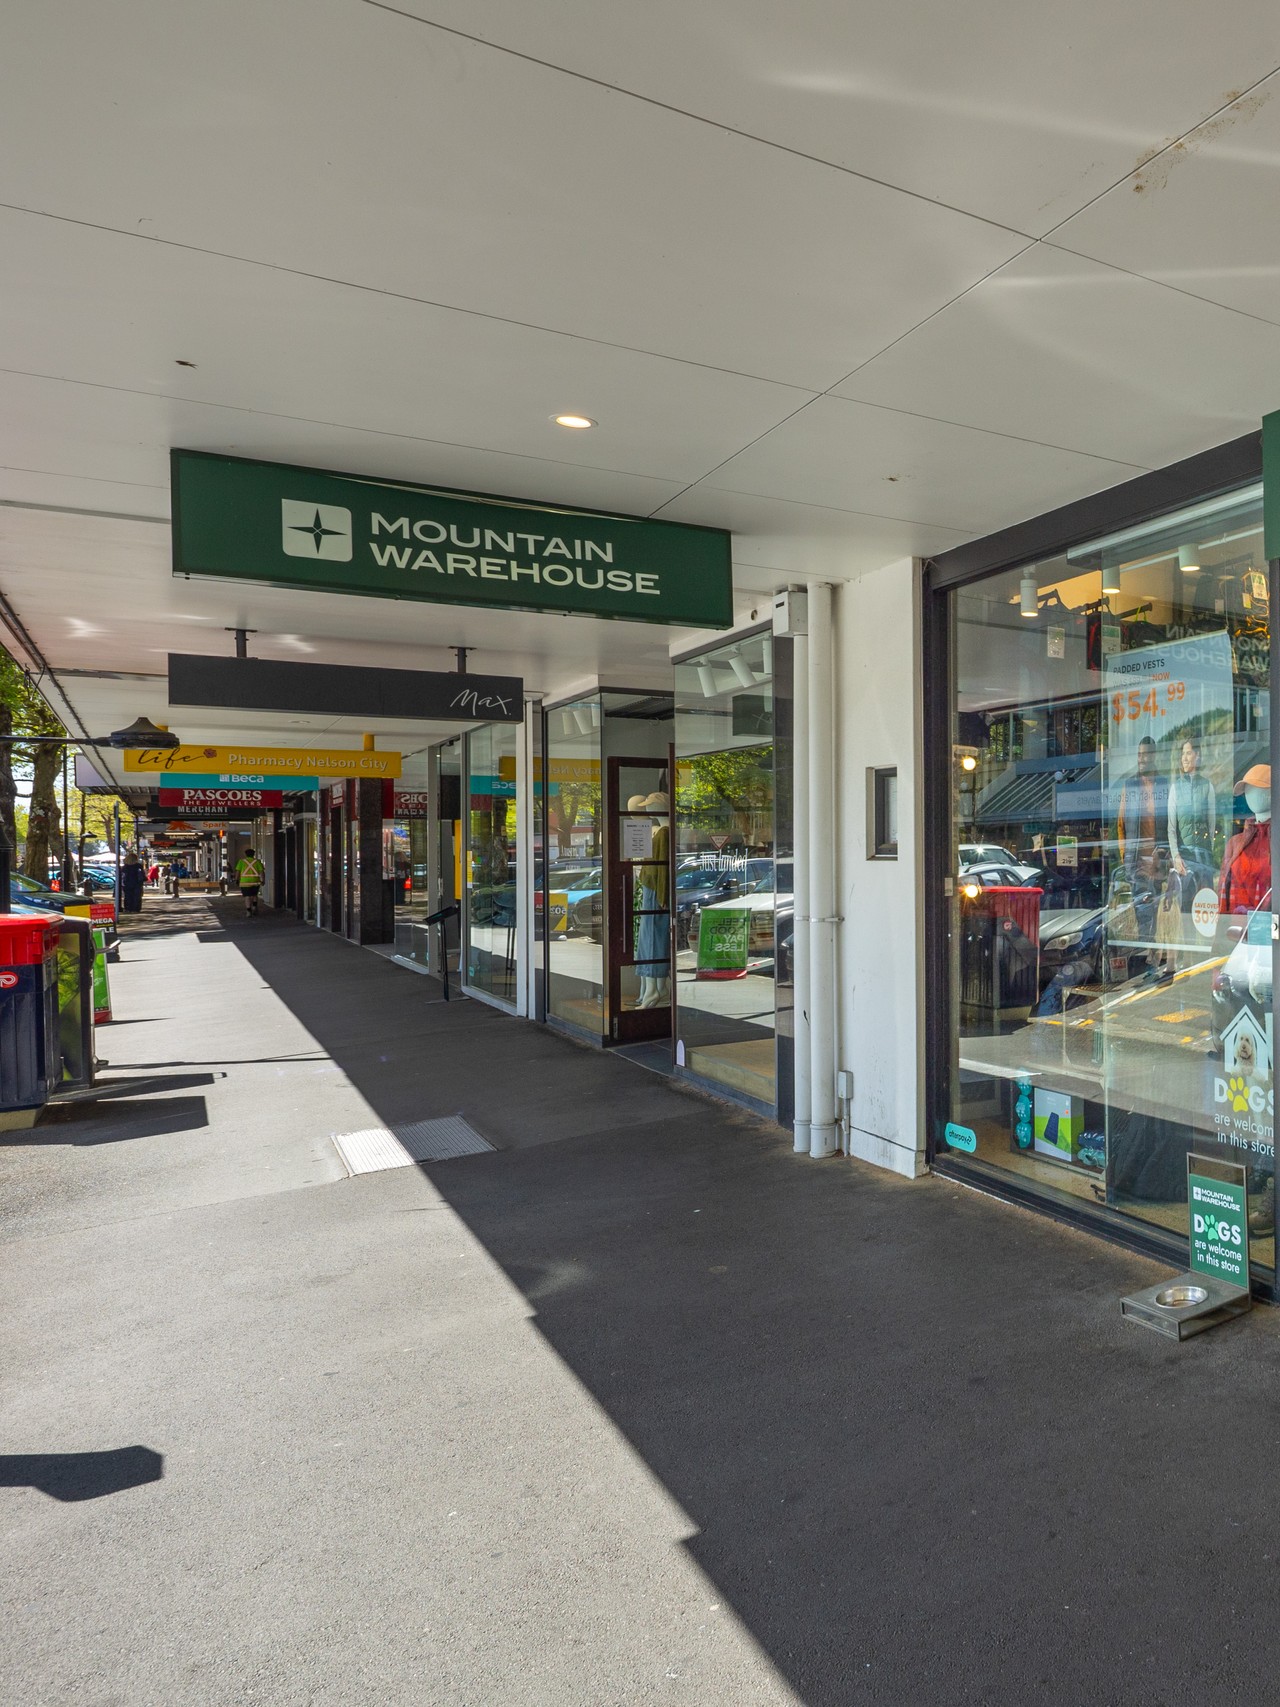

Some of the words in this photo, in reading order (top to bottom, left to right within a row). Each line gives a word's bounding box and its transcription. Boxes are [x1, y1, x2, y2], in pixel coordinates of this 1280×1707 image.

[371, 511, 614, 563] MOUNTAIN
[368, 542, 661, 595] WAREHOUSE
[1113, 662, 1141, 675] PADDED
[1142, 658, 1165, 670] VESTS
[1152, 672, 1171, 681] NOW
[228, 753, 303, 769] Pharmacy
[306, 756, 356, 768] Nelson
[359, 757, 388, 772] City
[231, 774, 264, 783] Beca
[182, 789, 262, 801] PASCOES
[177, 805, 228, 813] MERCHANT
[202, 821, 227, 829] Spark
[91, 917, 114, 925] MEGA
[1214, 1113, 1230, 1126] are
[1233, 1115, 1274, 1138] welcom
[1217, 1127, 1227, 1144] in
[1230, 1130, 1248, 1150] this
[1251, 1140, 1275, 1158] store
[1201, 1188, 1234, 1203] MOUNTAIN
[1201, 1195, 1240, 1212] WAREHOUSE
[1194, 1239, 1207, 1250] are
[1208, 1242, 1242, 1262] welcome
[1197, 1250, 1204, 1262] in
[1205, 1252, 1220, 1268] this
[1220, 1260, 1240, 1274] store
